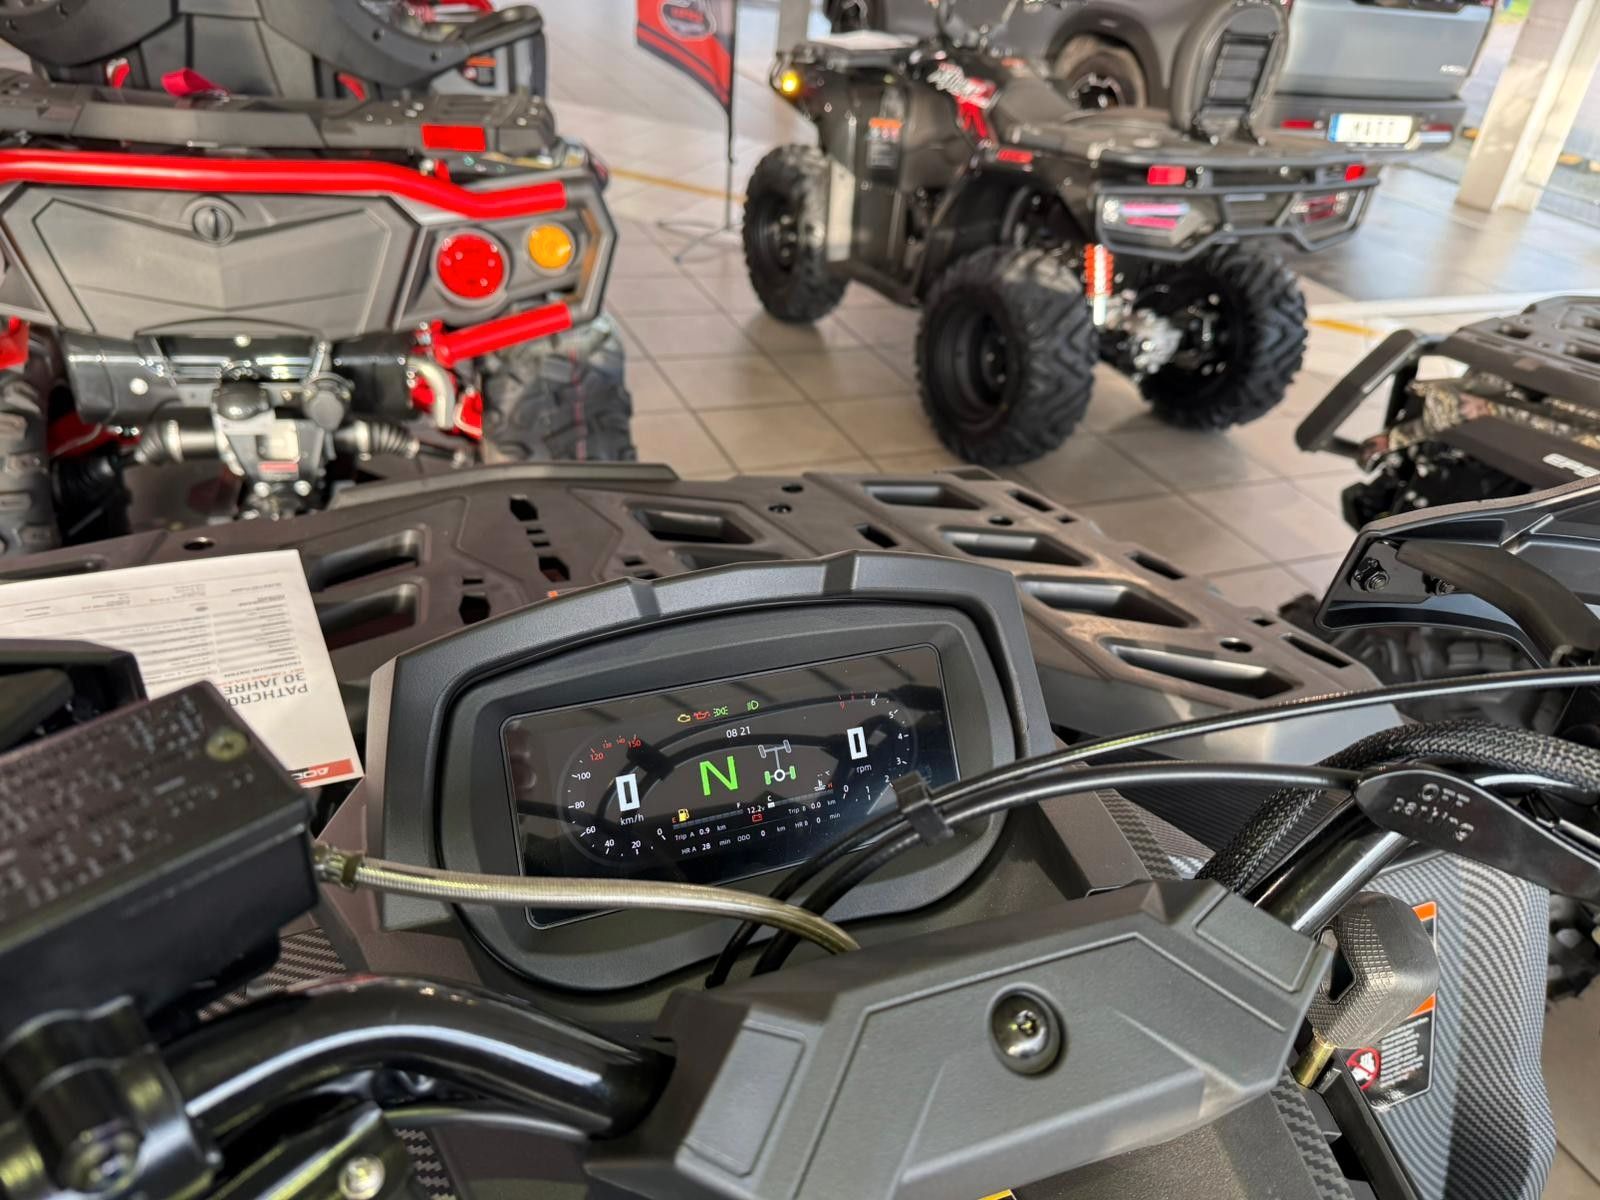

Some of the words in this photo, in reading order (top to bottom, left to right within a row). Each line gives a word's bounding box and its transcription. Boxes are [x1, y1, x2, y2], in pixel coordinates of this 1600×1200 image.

[284, 671, 305, 682] 30
[223, 676, 277, 696] JAHRE
[725, 728, 738, 739] 08
[740, 725, 751, 736] 21
[847, 726, 868, 760] 0
[590, 753, 604, 761] 120
[856, 763, 873, 775] rpm
[577, 771, 591, 781] 100
[700, 755, 739, 796] N
[615, 773, 641, 812] 0
[843, 785, 849, 793] 0
[1421, 783, 1471, 808] OFF
[574, 801, 585, 810] 80
[788, 808, 800, 816] Trip
[811, 802, 822, 810] 0.0
[620, 813, 645, 826] km/h
[829, 812, 841, 820] min
[585, 825, 597, 834] 60
[675, 833, 688, 841] Trip
[699, 827, 711, 836] 0.9
[717, 824, 727, 832] km
[777, 824, 786, 832] km
[604, 839, 615, 847] 40
[631, 840, 642, 849] 20
[702, 843, 712, 851] 28
[719, 838, 731, 846] min
